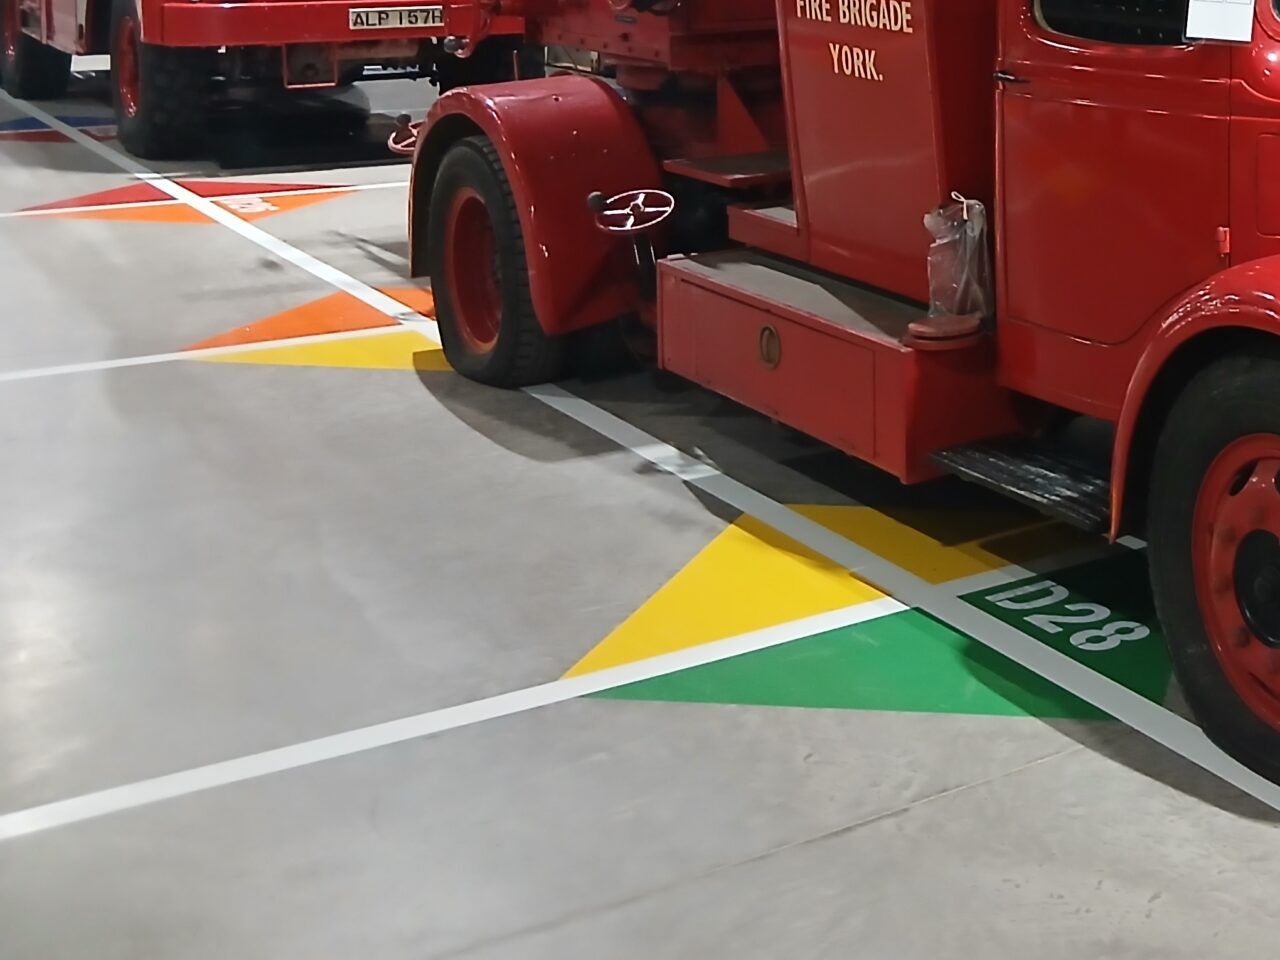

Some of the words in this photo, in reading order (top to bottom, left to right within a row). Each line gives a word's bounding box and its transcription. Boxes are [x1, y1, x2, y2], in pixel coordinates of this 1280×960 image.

[353, 12, 390, 27] ALP
[828, 42, 884, 81] YORK.
[984, 579, 1151, 651] D28
